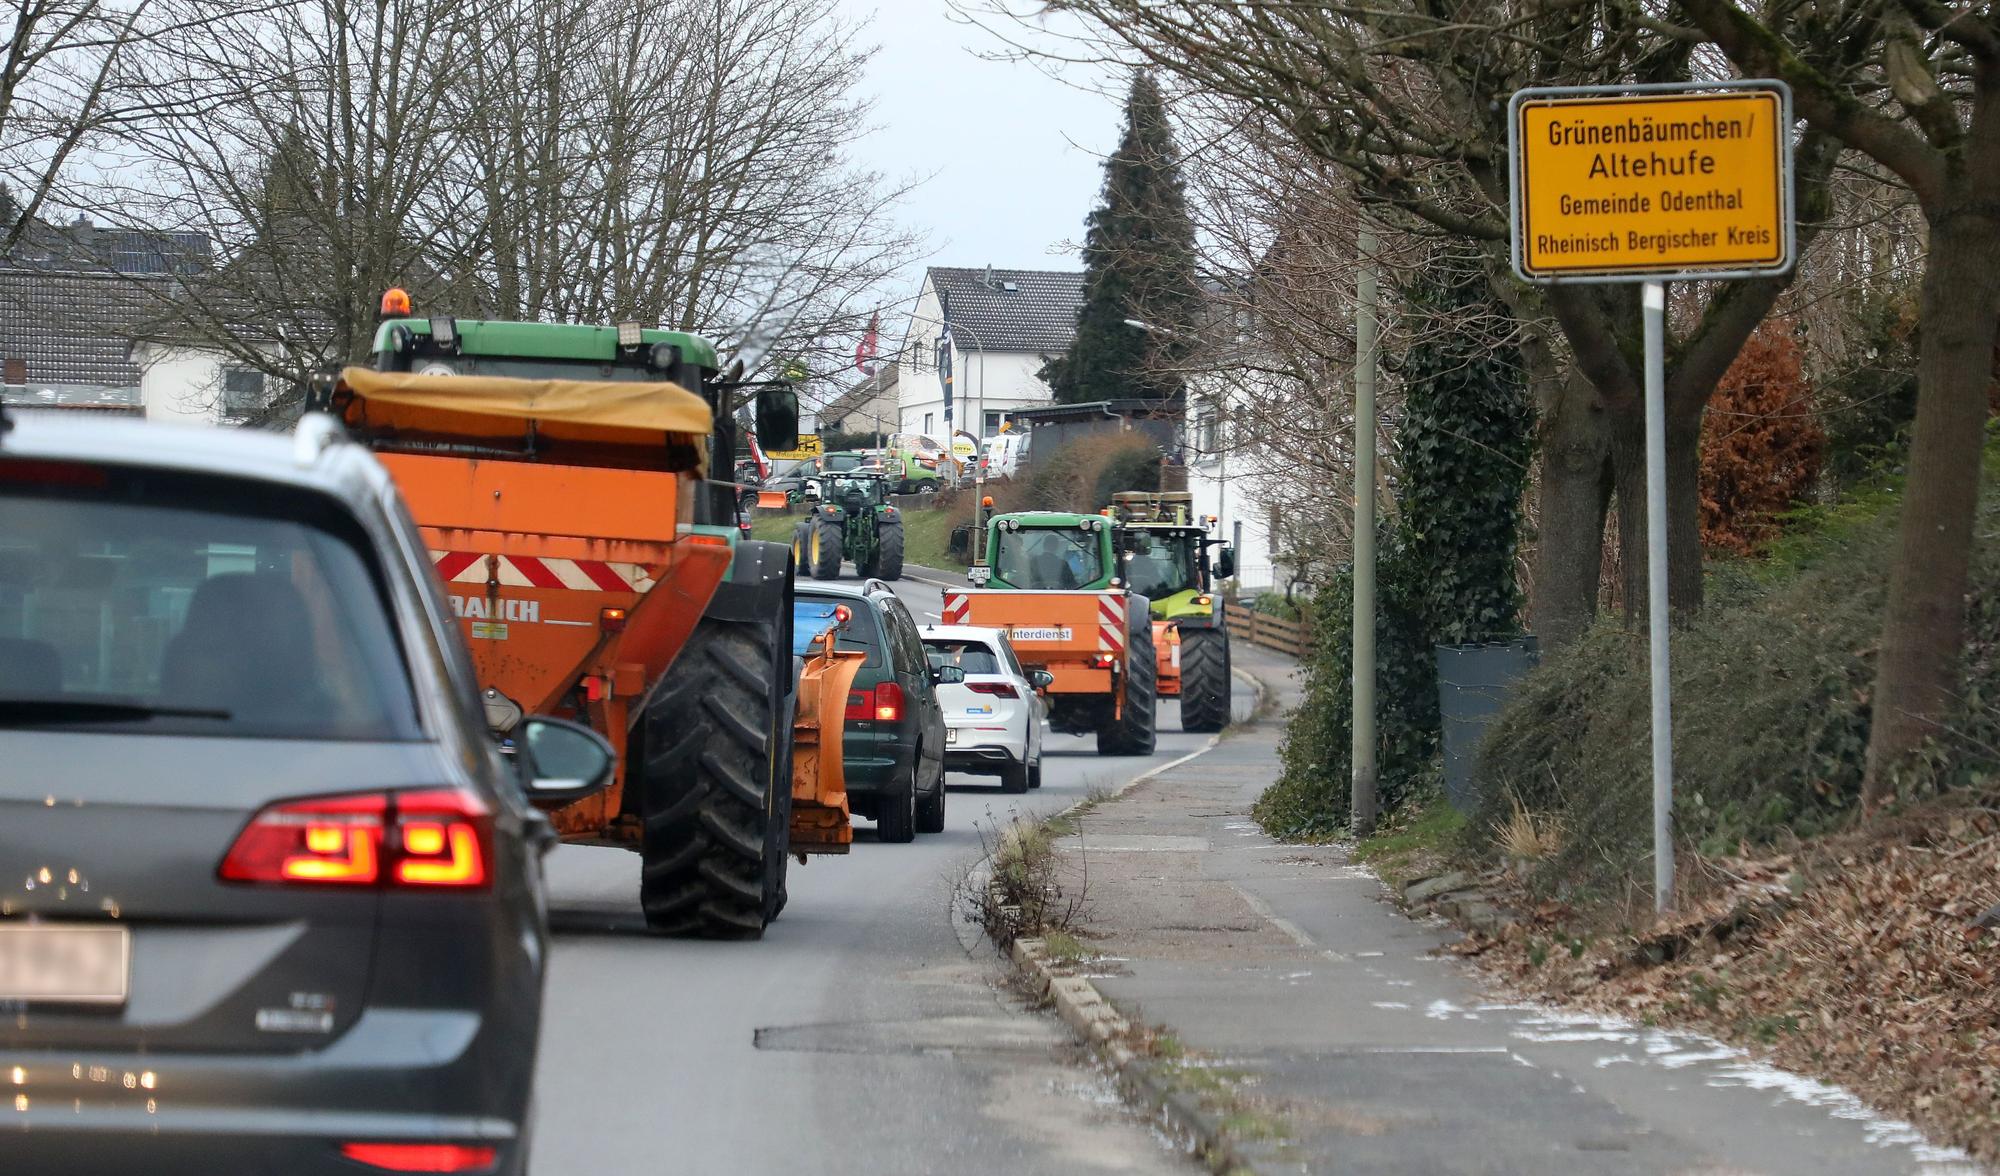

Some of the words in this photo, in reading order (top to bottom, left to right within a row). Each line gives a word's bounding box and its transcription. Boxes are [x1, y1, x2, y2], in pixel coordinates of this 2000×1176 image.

[1588, 151, 1716, 179] Altehufe
[1560, 193, 1651, 216] Gemeinde
[1660, 189, 1743, 212] Odenthal
[1537, 233, 1619, 255] Rheinisch
[1628, 229, 1718, 254] Bergischer
[1727, 226, 1770, 246] Kreis
